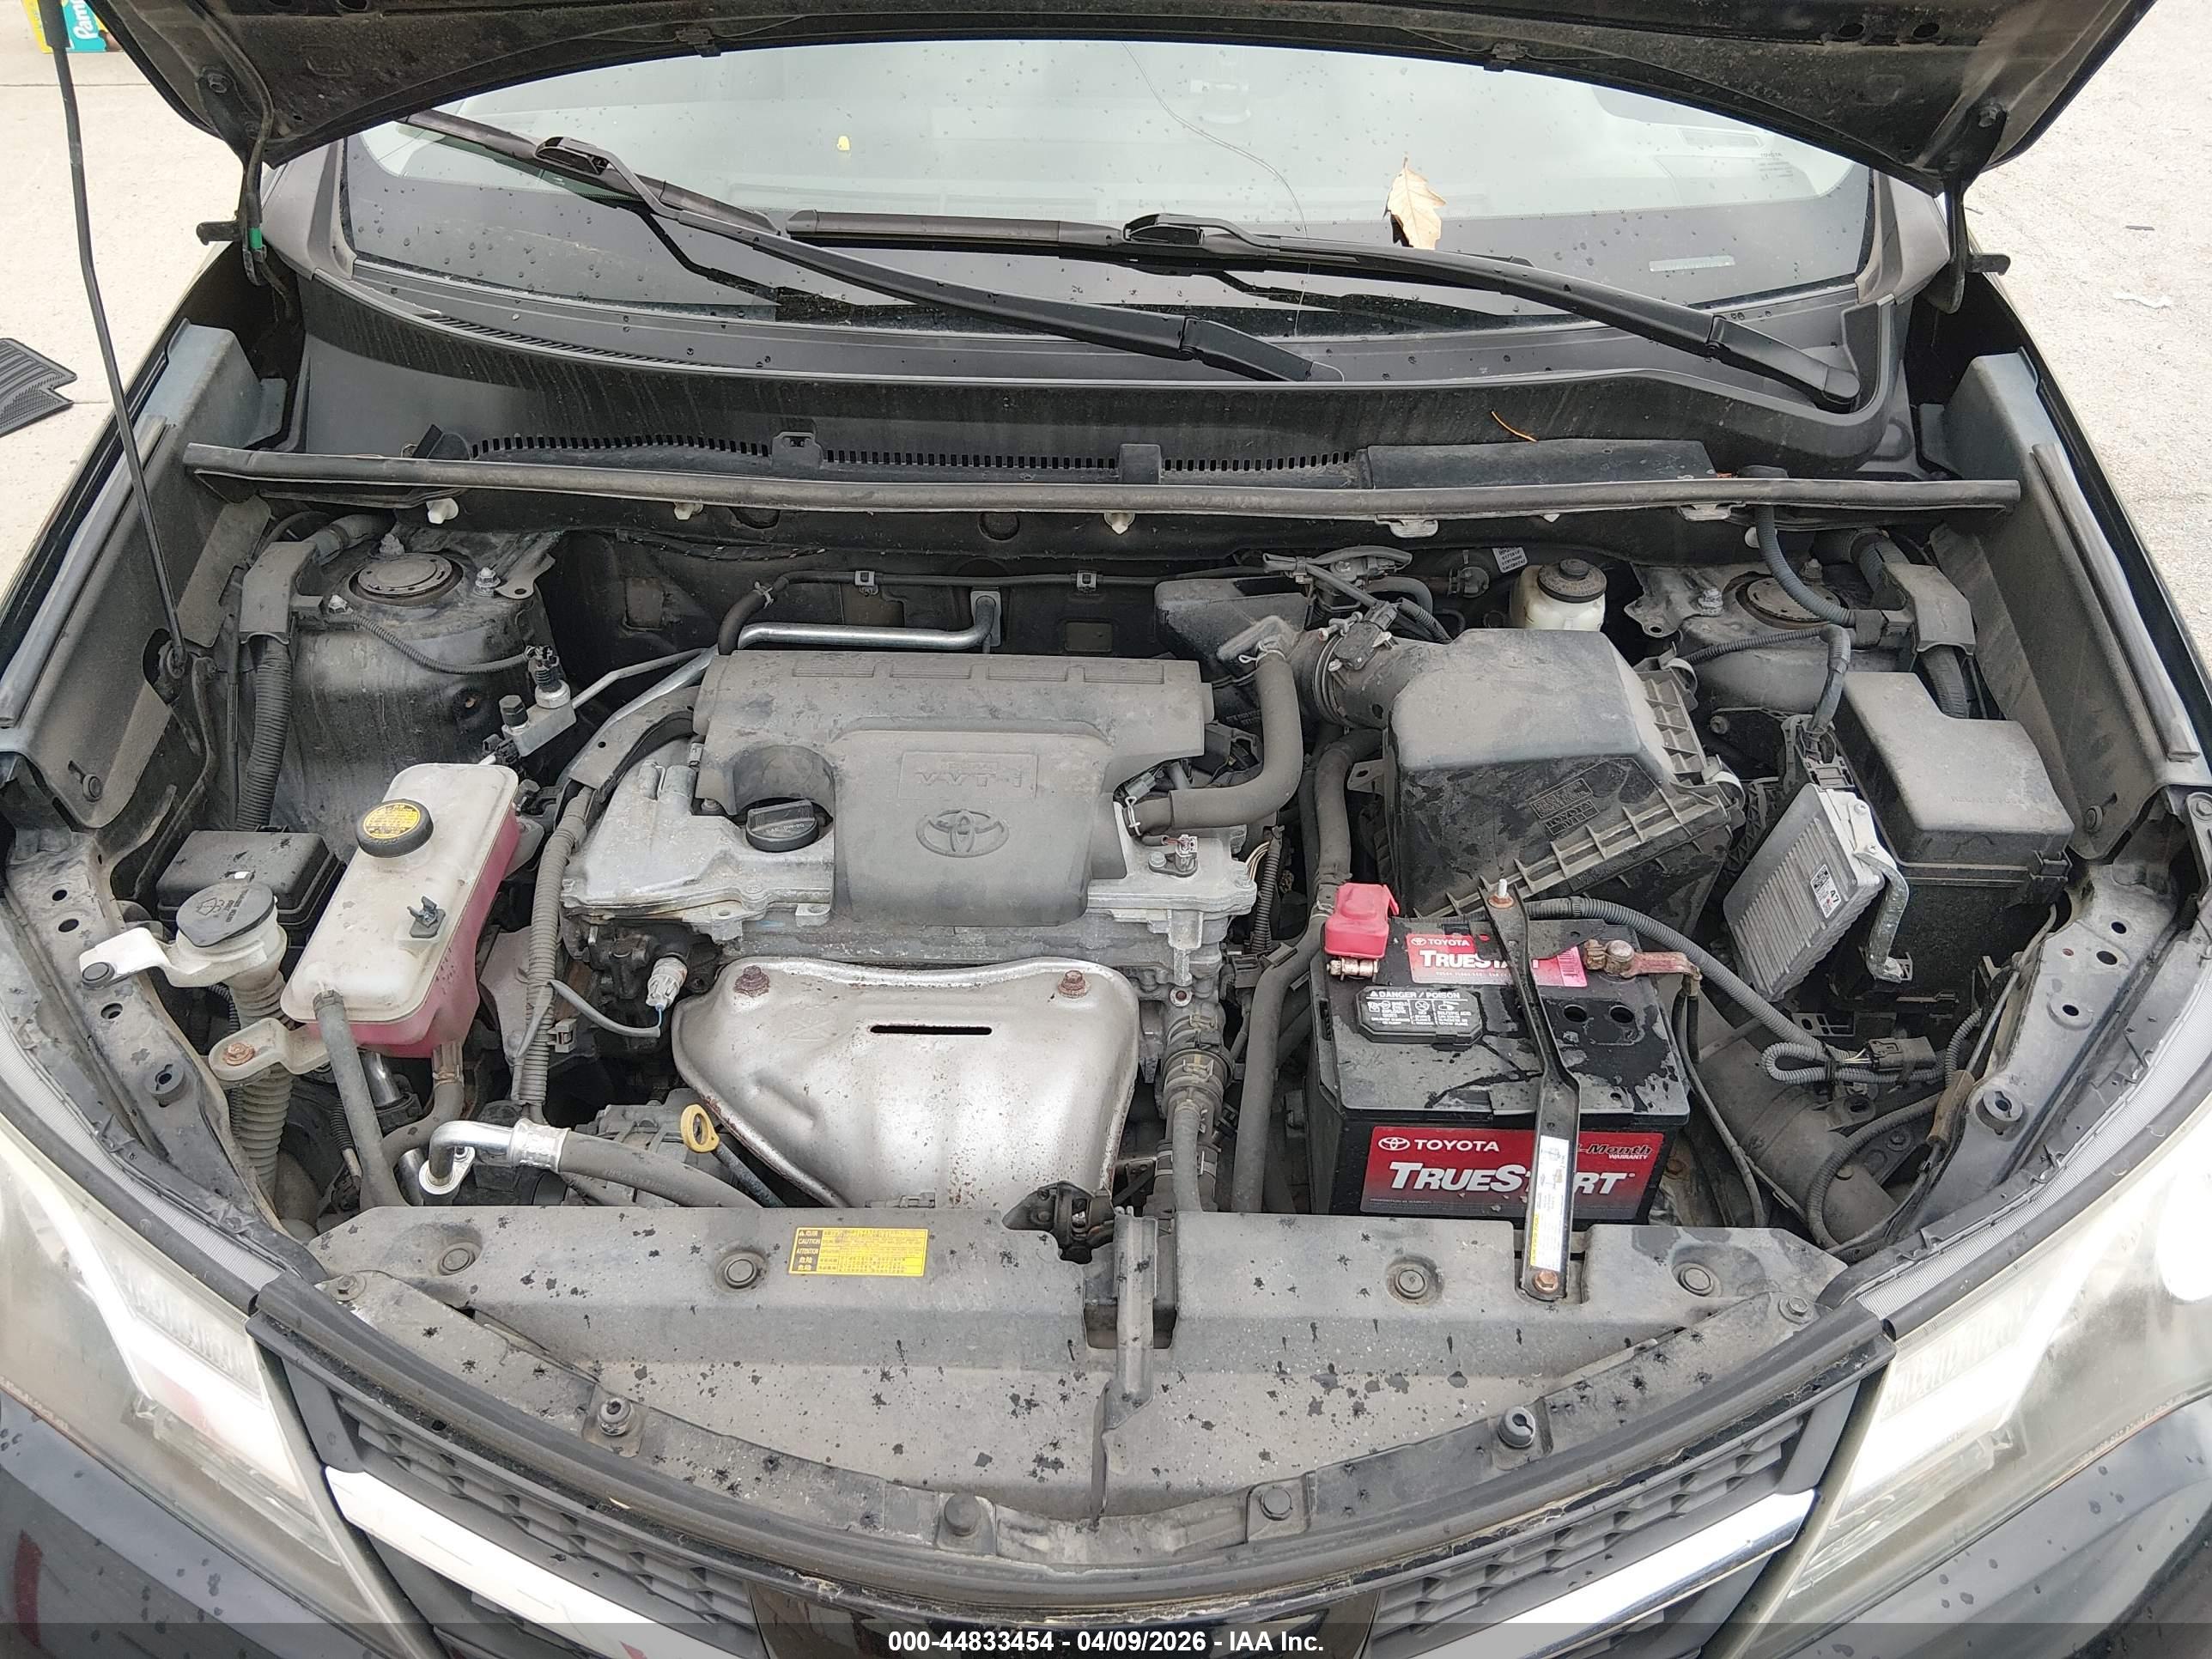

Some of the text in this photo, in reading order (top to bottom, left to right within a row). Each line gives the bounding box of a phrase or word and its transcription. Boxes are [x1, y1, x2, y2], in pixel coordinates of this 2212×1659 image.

[1428, 938, 1471, 947] TOYOTA
[1413, 1139, 1500, 1152] TOYOTA
[1389, 1162, 1628, 1195] TRUESRT
